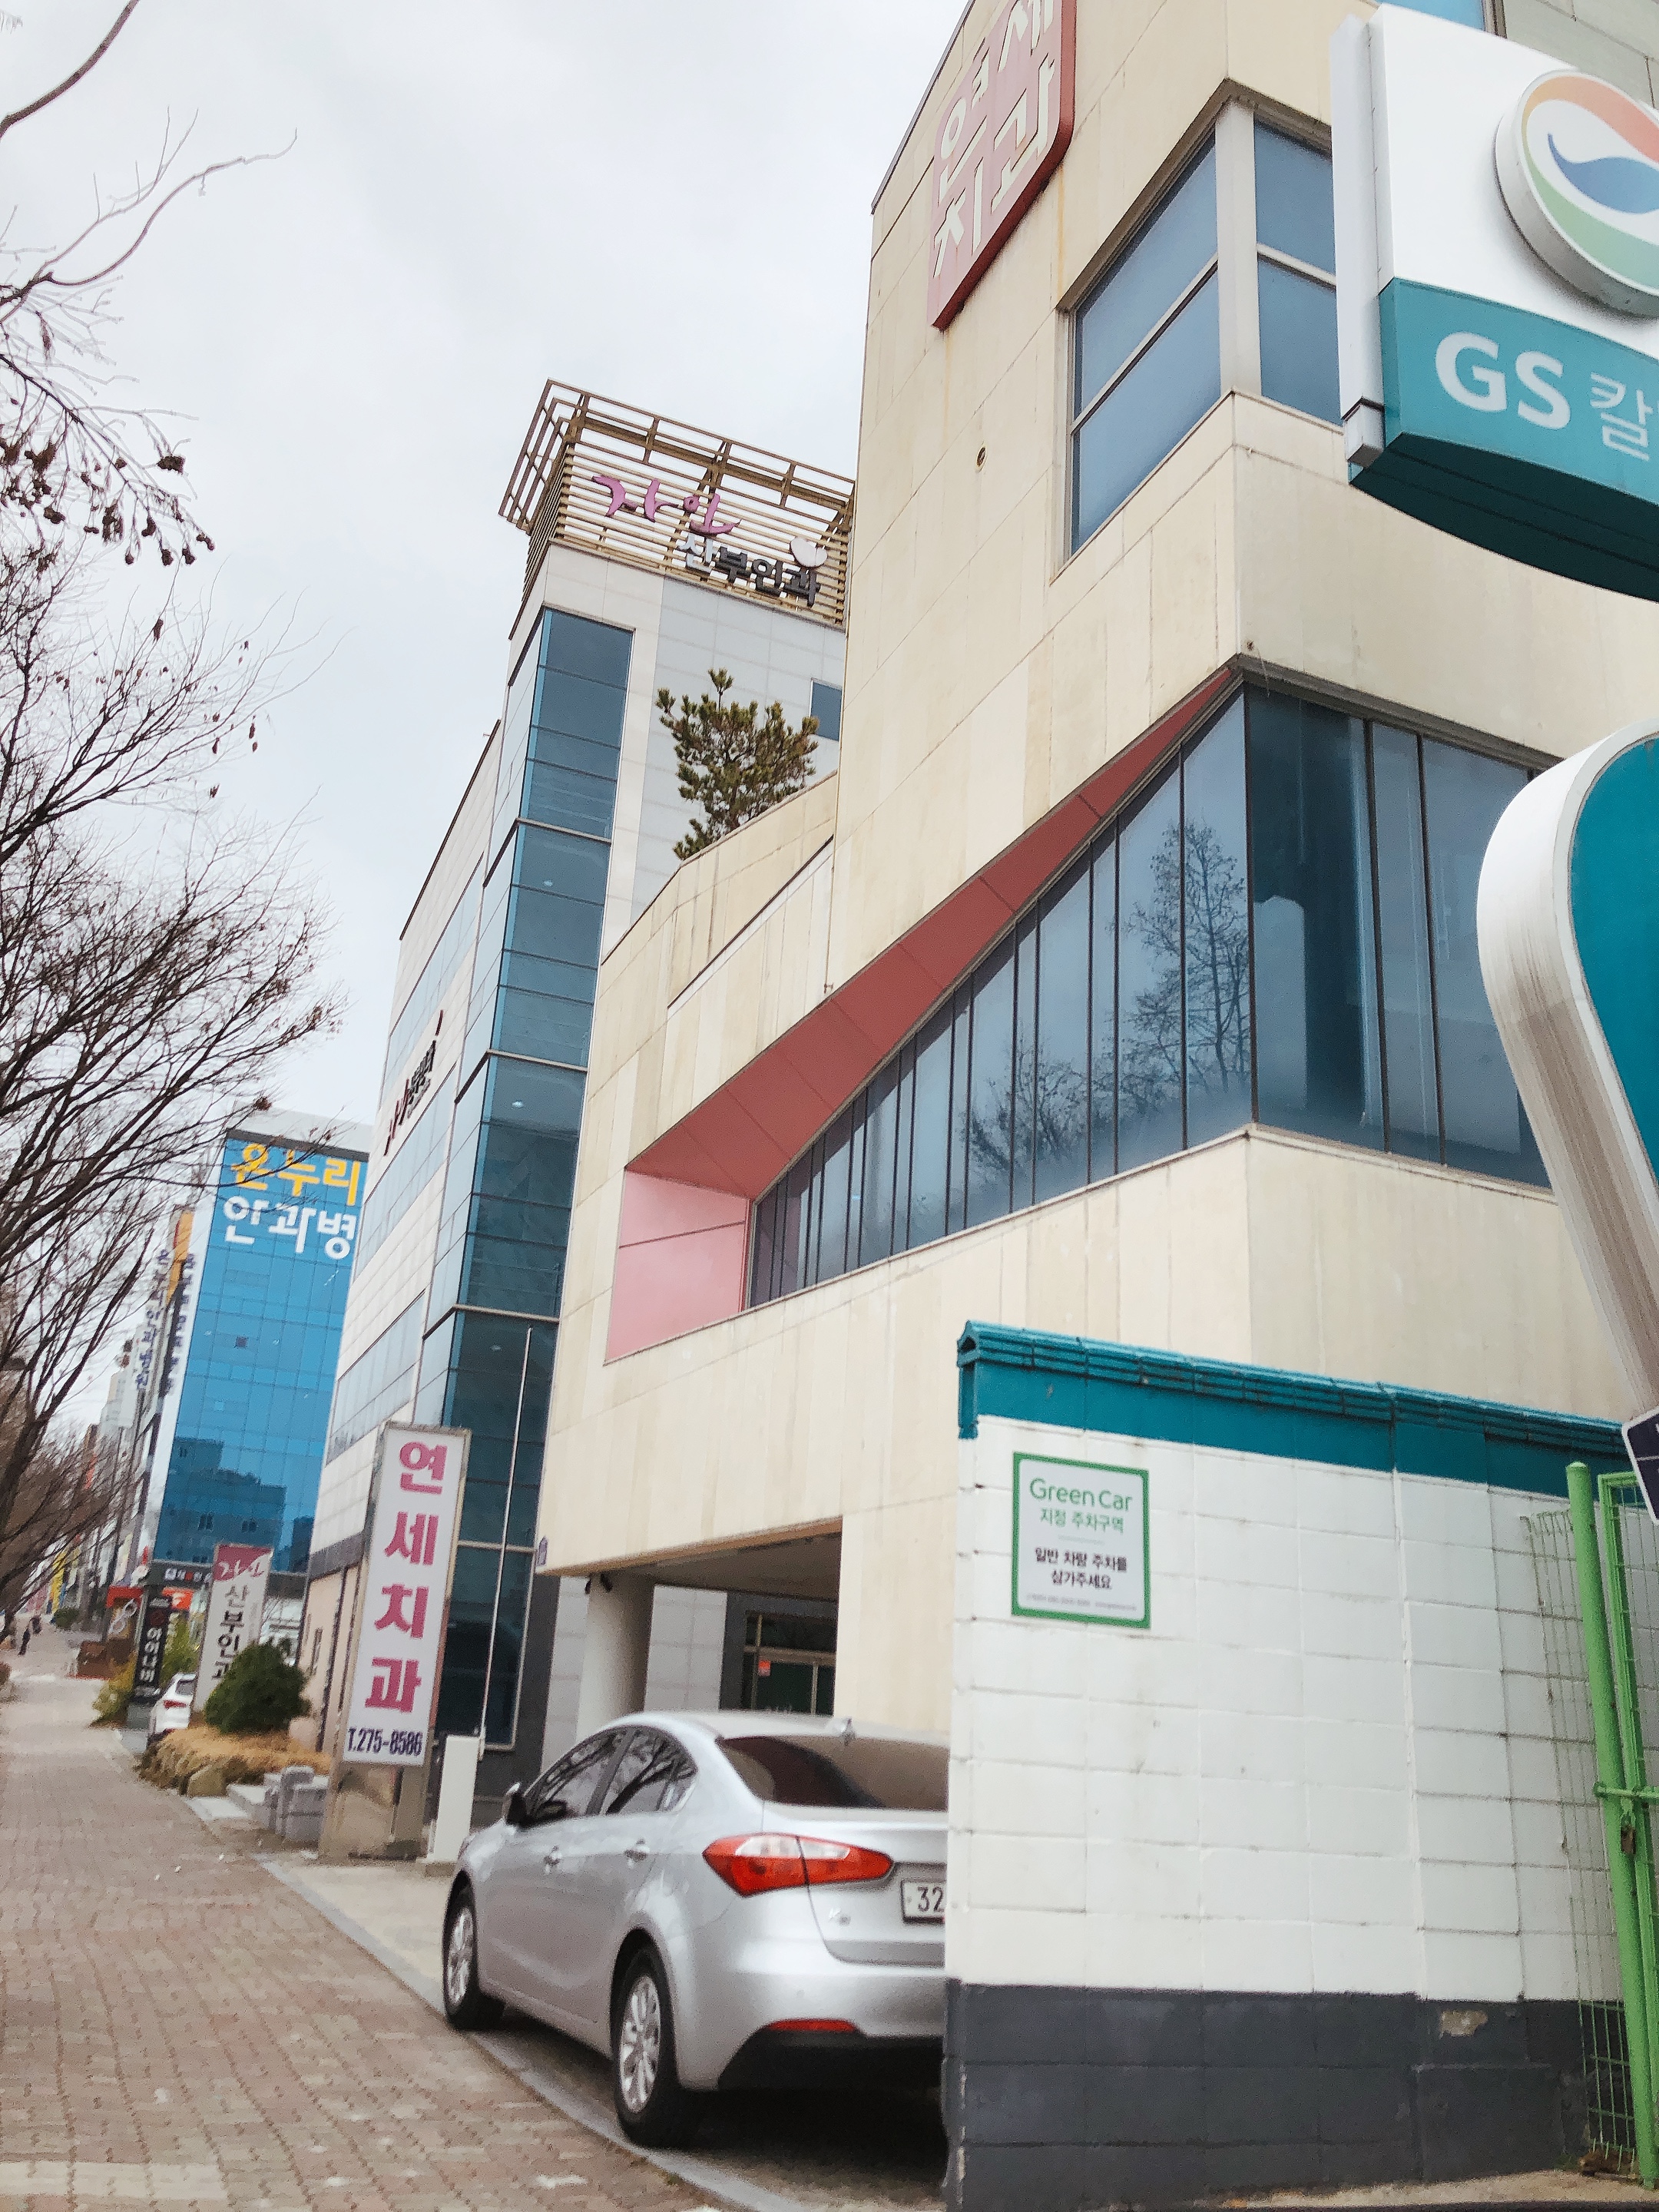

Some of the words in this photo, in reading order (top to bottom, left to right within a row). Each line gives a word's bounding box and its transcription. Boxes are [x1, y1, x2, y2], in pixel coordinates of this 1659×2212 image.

[933, 54, 1055, 278] 치과
[677, 531, 821, 607] 산부인과
[231, 1143, 361, 1207] 온누리
[1071, 1510, 1124, 1534] 주차구역
[364, 1441, 448, 1714] 연세치과
[1035, 1547, 1058, 1565] 일반
[1064, 1550, 1088, 1568] 차량
[1092, 1552, 1128, 1573] 주차를
[1051, 1569, 1112, 1590] 삼가주세요
[348, 1725, 423, 1757] T.275-8586
